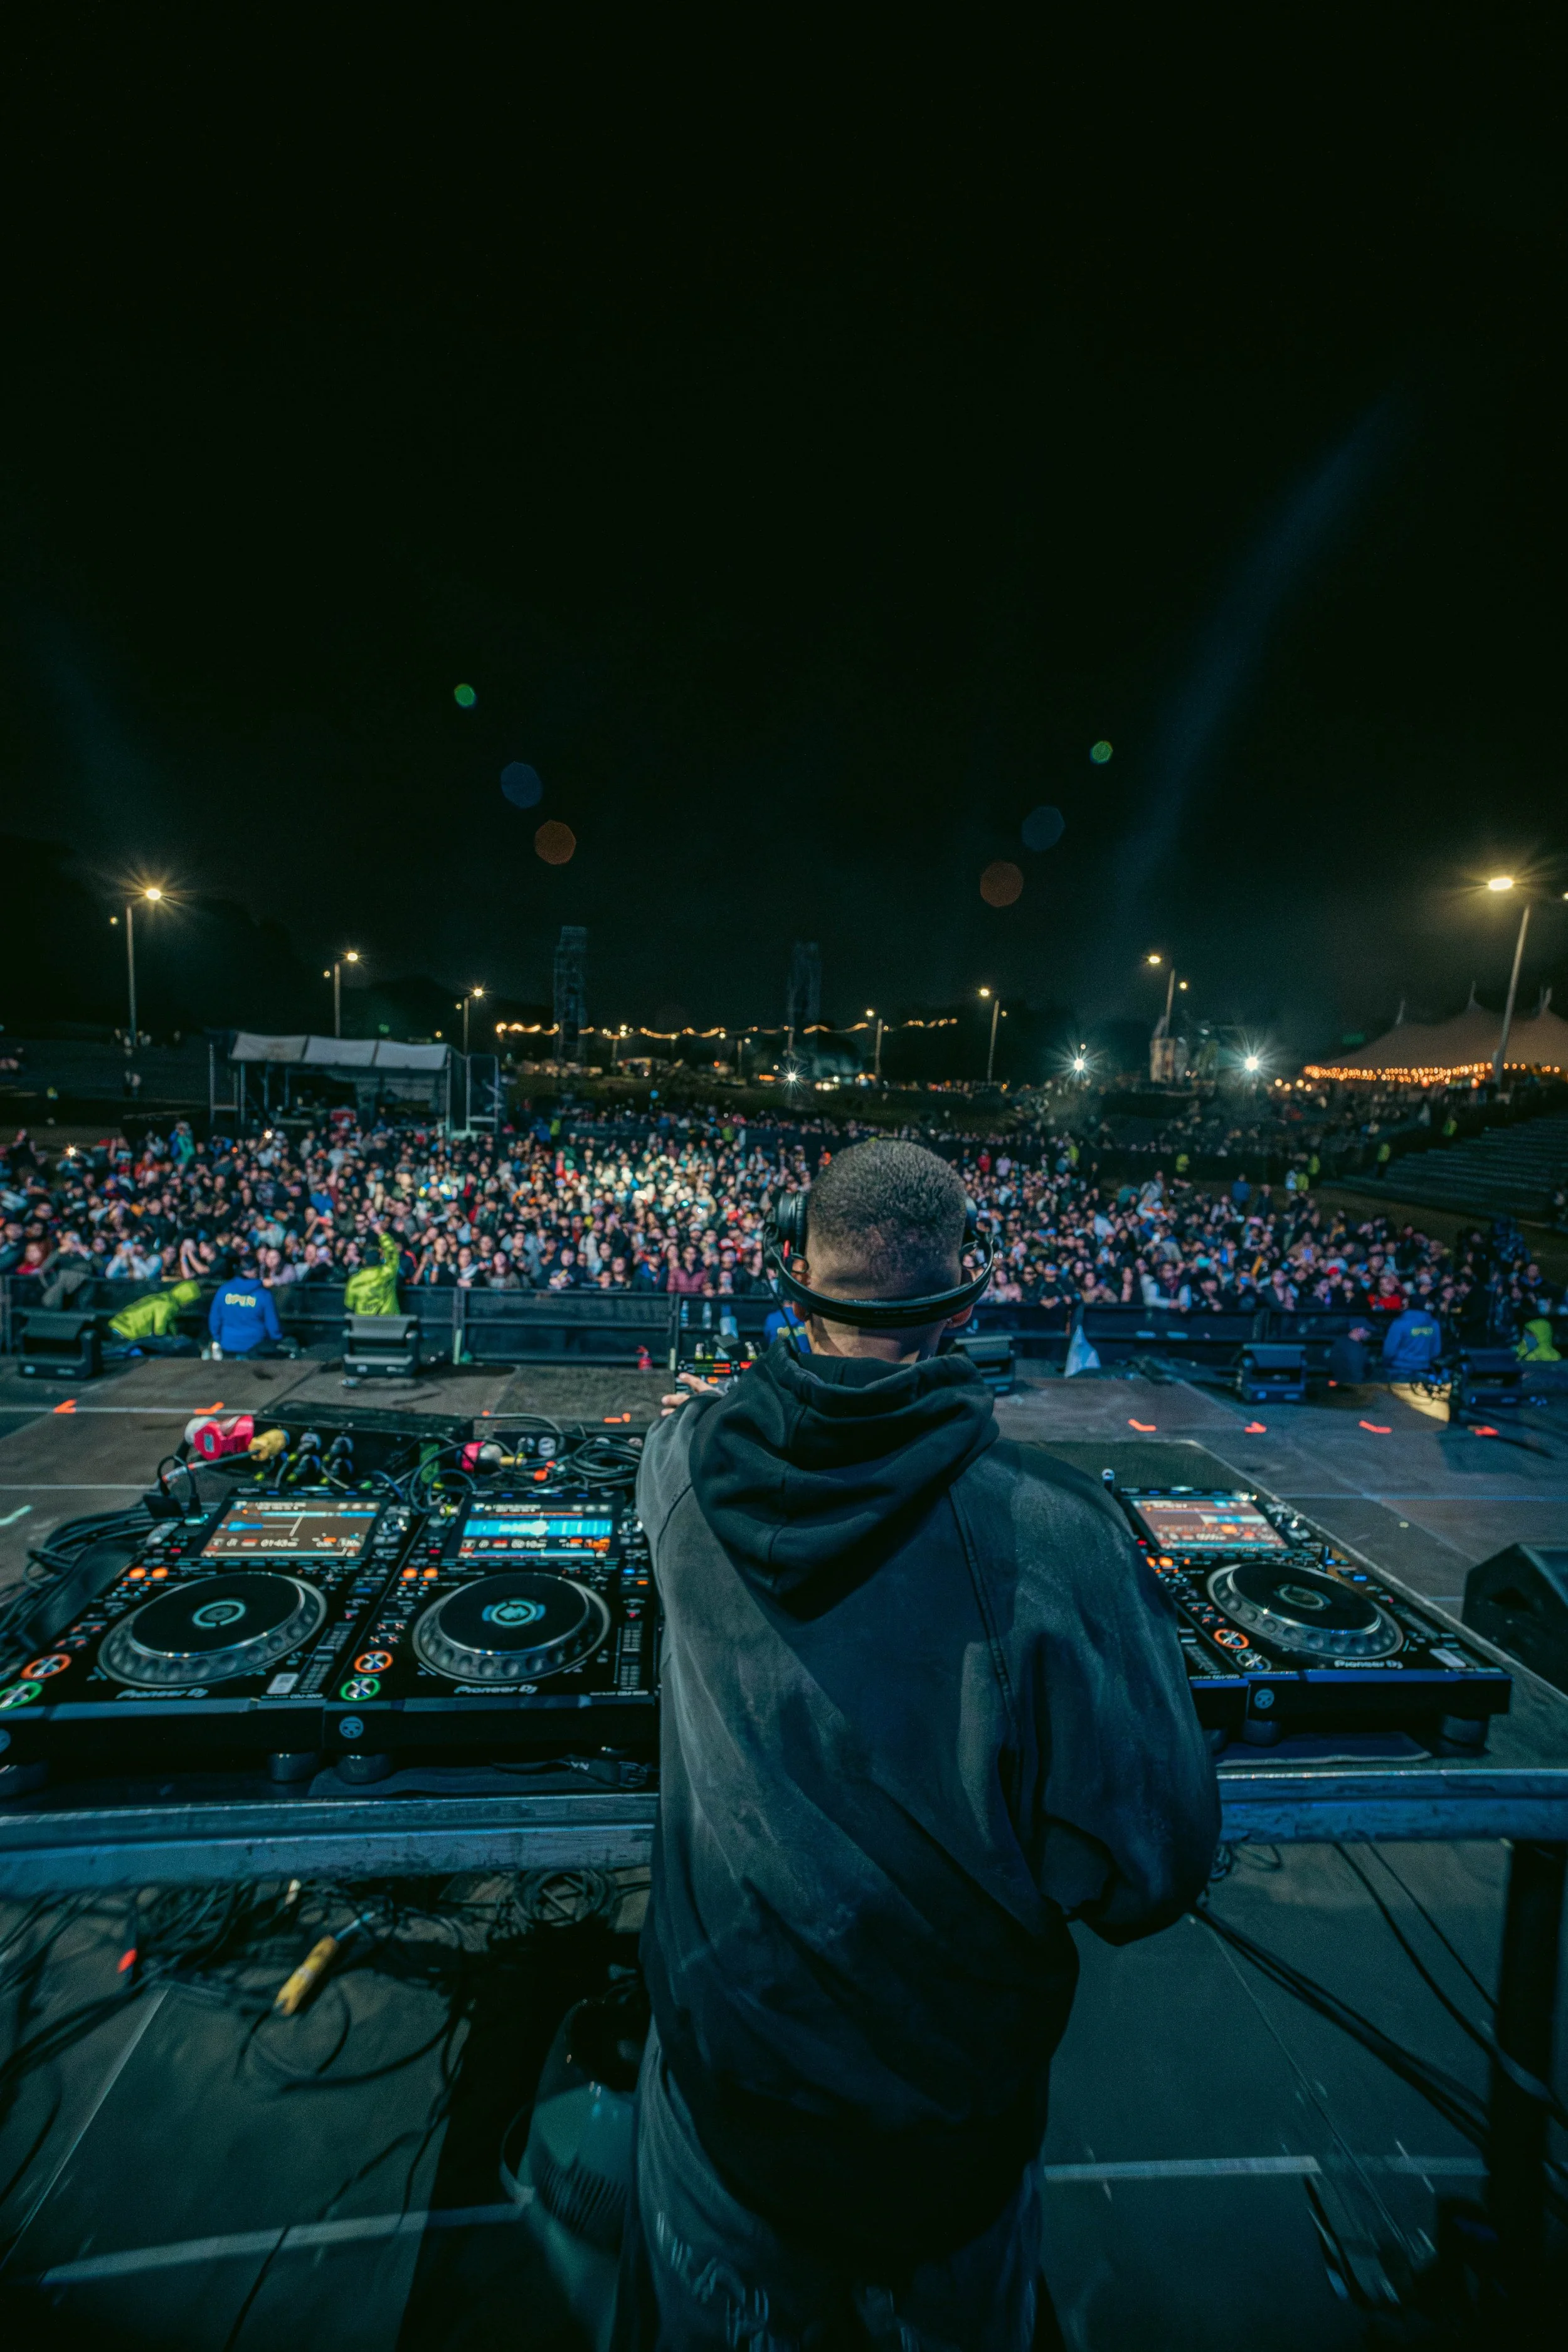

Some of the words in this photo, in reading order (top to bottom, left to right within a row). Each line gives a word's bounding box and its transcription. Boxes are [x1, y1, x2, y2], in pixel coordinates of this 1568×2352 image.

[1333, 1660, 1385, 1668] Pioneer
[115, 1688, 188, 1700] Pioneer
[453, 1685, 519, 1695] Pioneer
[518, 1684, 539, 1694] DJ
